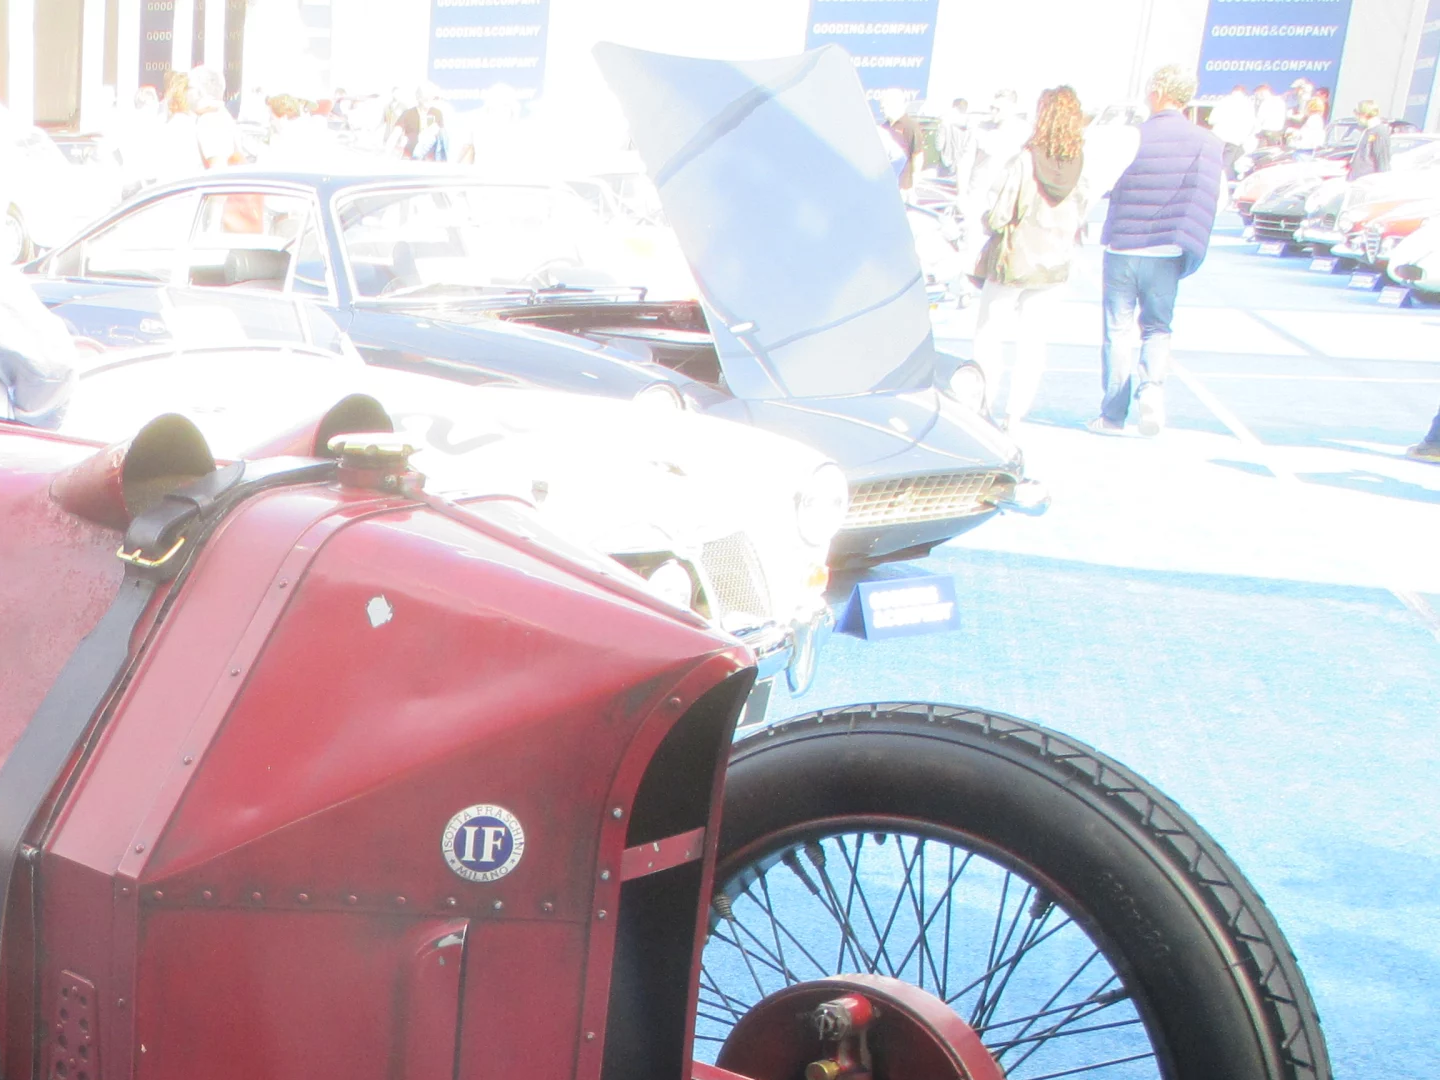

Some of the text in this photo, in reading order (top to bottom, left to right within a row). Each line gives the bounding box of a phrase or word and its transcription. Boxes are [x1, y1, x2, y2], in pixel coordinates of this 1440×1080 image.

[435, 24, 542, 38] GOODING&COMPANY
[812, 23, 929, 35] GOODING&COMPANY
[1211, 24, 1338, 37] GOODING&COMPANY
[850, 56, 924, 68] G&COMPANY
[1205, 60, 1332, 72] GOODING&COMPANY
[443, 806, 523, 857] ISOTTA FRASCHINI
[461, 825, 506, 863] IF
[455, 865, 509, 881] MILANO
